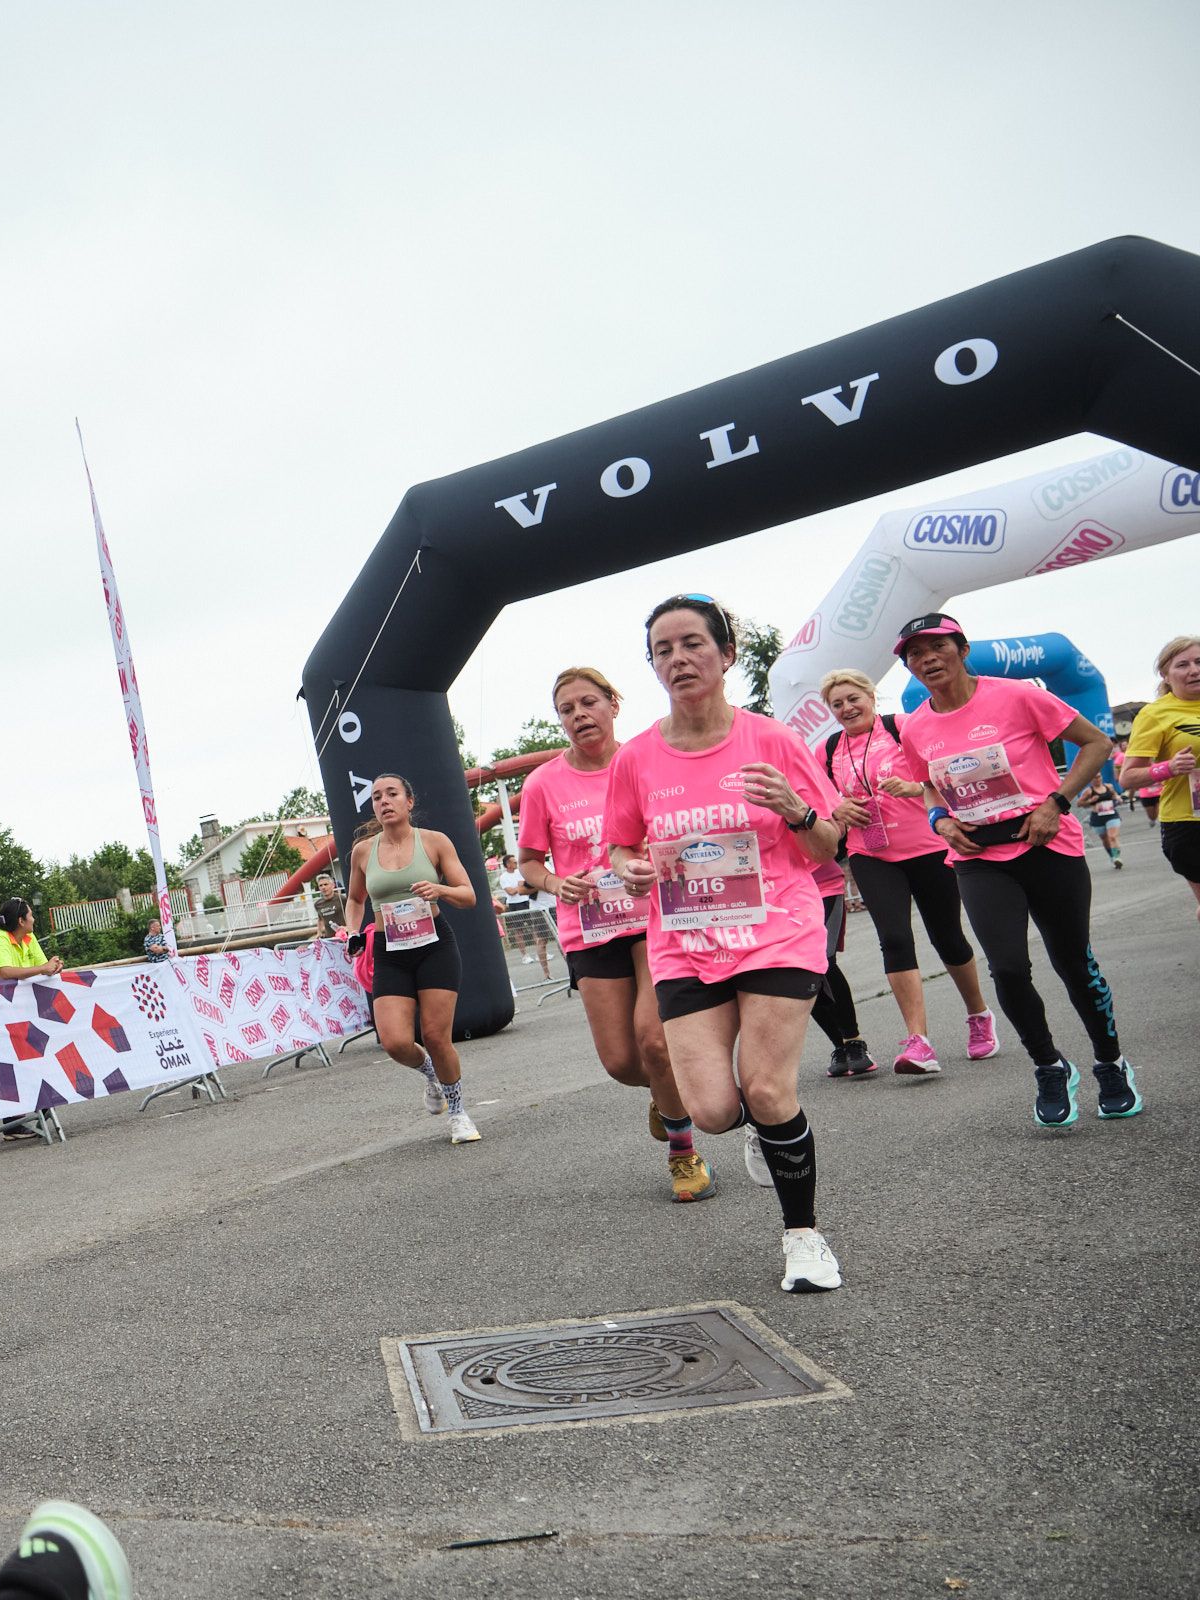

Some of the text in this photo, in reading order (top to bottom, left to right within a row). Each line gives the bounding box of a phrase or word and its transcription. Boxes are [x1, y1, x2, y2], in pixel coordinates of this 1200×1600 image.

[494, 338, 999, 528] VOLVO
[1042, 450, 1133, 511] COSMO
[913, 514, 998, 546] COSMO
[837, 558, 892, 632] COSMO
[956, 780, 988, 797] 016
[559, 799, 588, 812] OYSHO
[653, 803, 750, 839] CARRERA
[684, 850, 722, 860] ASTURIANA
[687, 877, 725, 895] 016
[603, 899, 634, 913] 016
[699, 895, 714, 903] 420
[398, 921, 417, 932] 016
[671, 913, 753, 926] OYSHO Santander
[712, 950, 735, 963] 202
[268, 975, 294, 992] COSMO
[245, 978, 266, 1007] COSMO
[193, 996, 224, 1024] COSMO
[271, 1004, 291, 1034] COSMO
[149, 1028, 179, 1039] Experience
[241, 1023, 267, 1045] COSMO
[160, 1053, 191, 1070] OMAN
[775, 1165, 811, 1180] SPORTLAST
